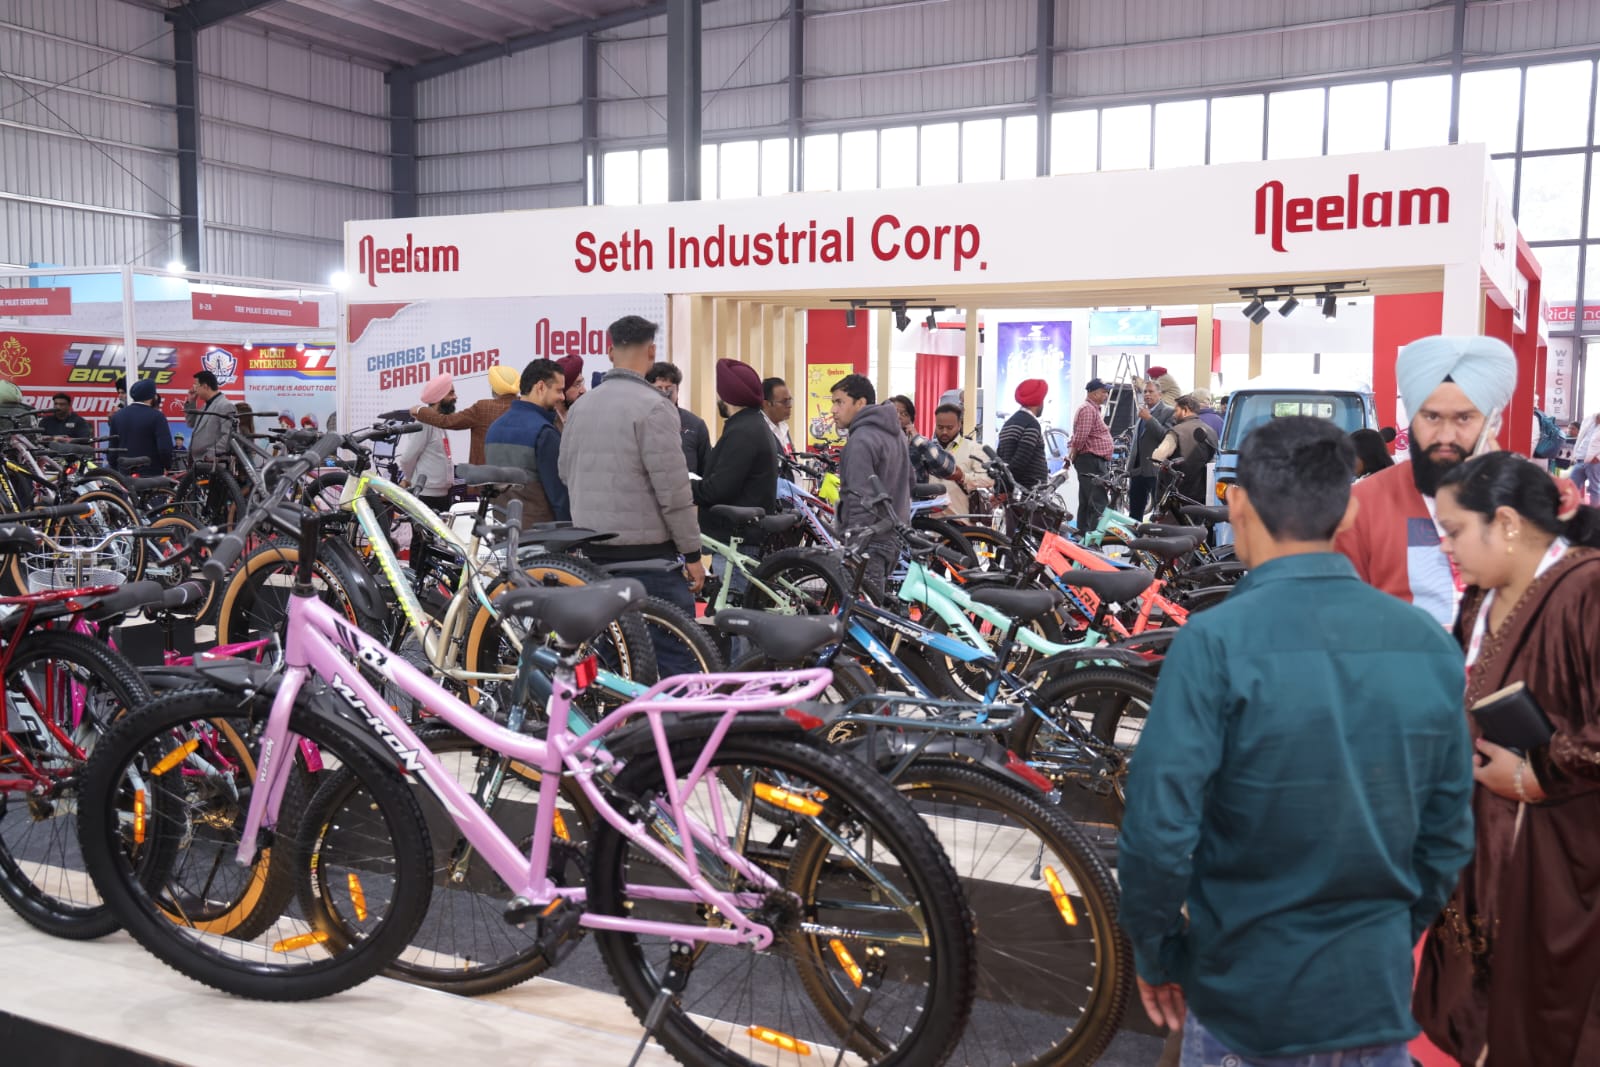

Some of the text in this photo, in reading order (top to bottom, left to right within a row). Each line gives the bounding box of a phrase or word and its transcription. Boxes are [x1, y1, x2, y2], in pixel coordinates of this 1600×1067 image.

[1255, 173, 1450, 253] Neelam
[358, 233, 460, 288] Neelam
[574, 214, 988, 273] Seth Industrial Corp.
[259, 348, 286, 359] PULKIT
[367, 336, 472, 372] CHARGE LESS
[535, 316, 613, 358] Neela
[249, 359, 297, 369] ENTERPRISES
[380, 348, 500, 391] EARN MORE
[1552, 349, 1568, 414] WELCOME
[71, 396, 121, 412] WITH
[332, 672, 425, 771] YU-KON
[260, 736, 275, 783] YU-KON
